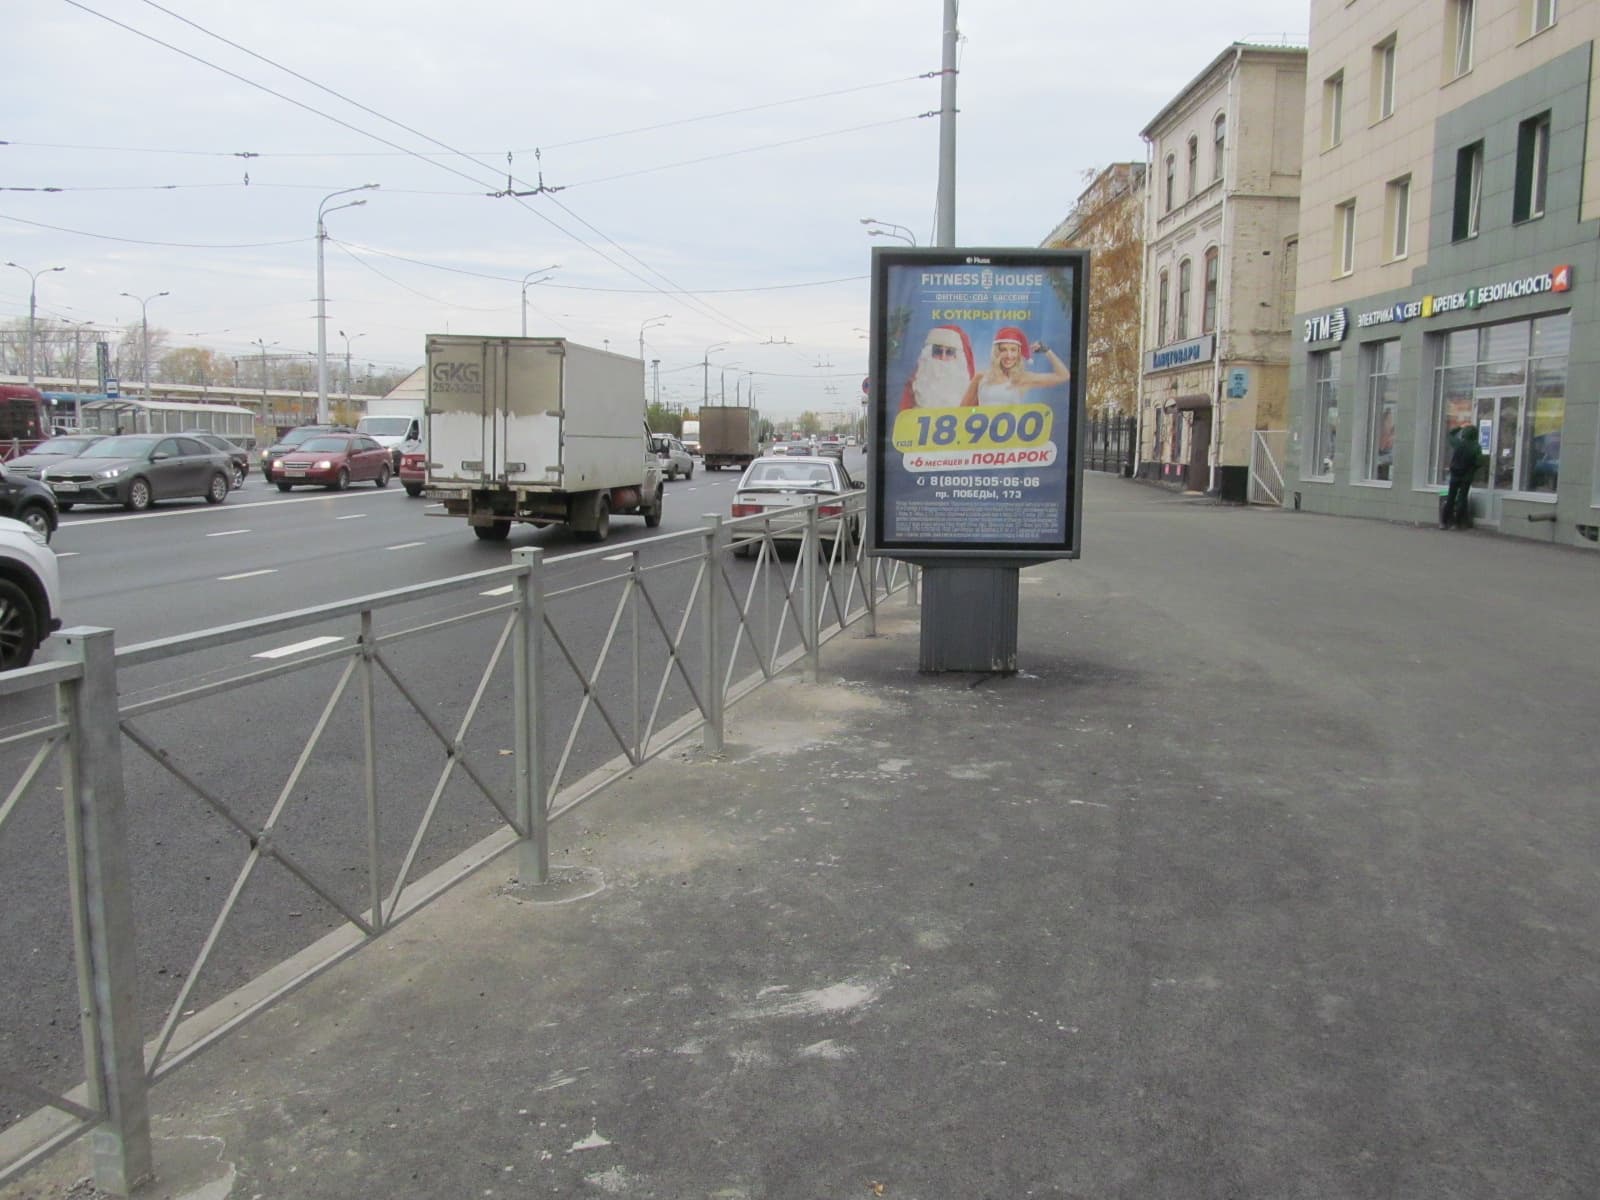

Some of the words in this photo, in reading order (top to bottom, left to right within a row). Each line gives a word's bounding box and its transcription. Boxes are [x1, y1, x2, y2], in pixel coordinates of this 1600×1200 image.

[921, 273, 979, 287] FITNESS
[994, 273, 1043, 287] HOUSE
[1357, 306, 1394, 328] ЭЛЕКТРИКА
[1403, 301, 1422, 318] СВЕТ
[1433, 291, 1466, 313] КРЕПЕЖ
[1477, 273, 1552, 304] БЕЗОПАСНОСТЬ
[931, 309, 941, 321] К
[943, 309, 1032, 321] ОТКРЫТИЮ!
[1303, 314, 1330, 343] ЭТМ
[433, 362, 481, 383] GKG
